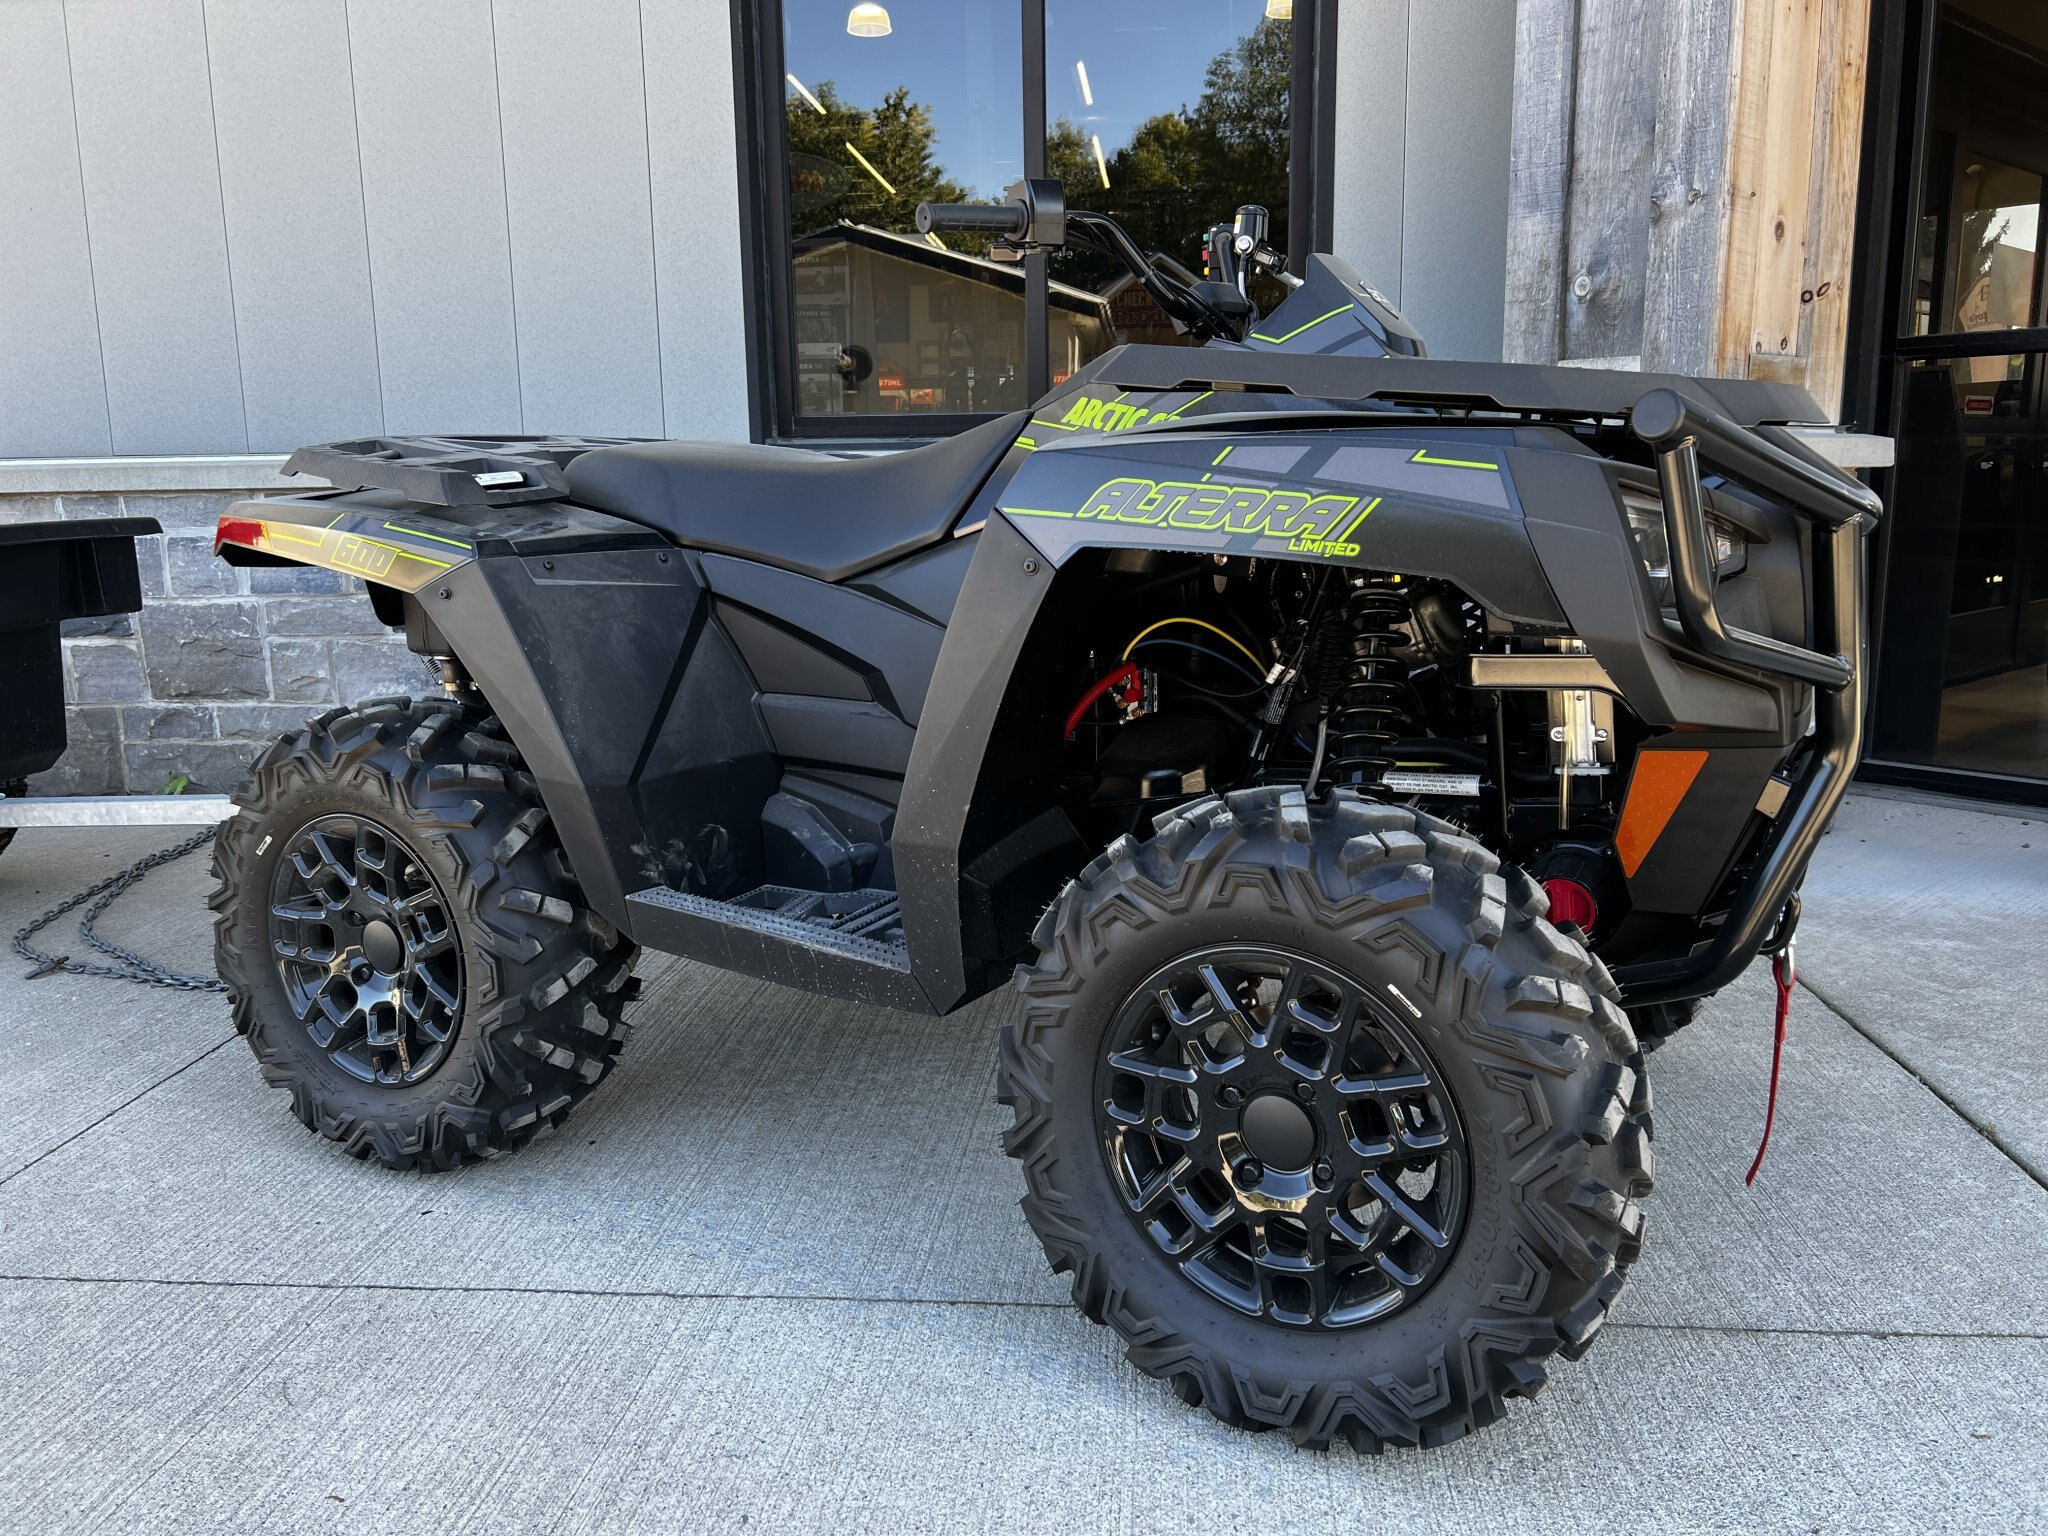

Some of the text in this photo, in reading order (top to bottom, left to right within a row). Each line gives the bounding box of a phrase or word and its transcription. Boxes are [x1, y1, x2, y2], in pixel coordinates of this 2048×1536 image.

[879, 379, 902, 387] STIHL
[1061, 396, 1149, 432] ARCTIC
[1076, 477, 1361, 541] ALTERRA
[331, 533, 400, 578] 600
[1288, 537, 1361, 557] LIMITED
